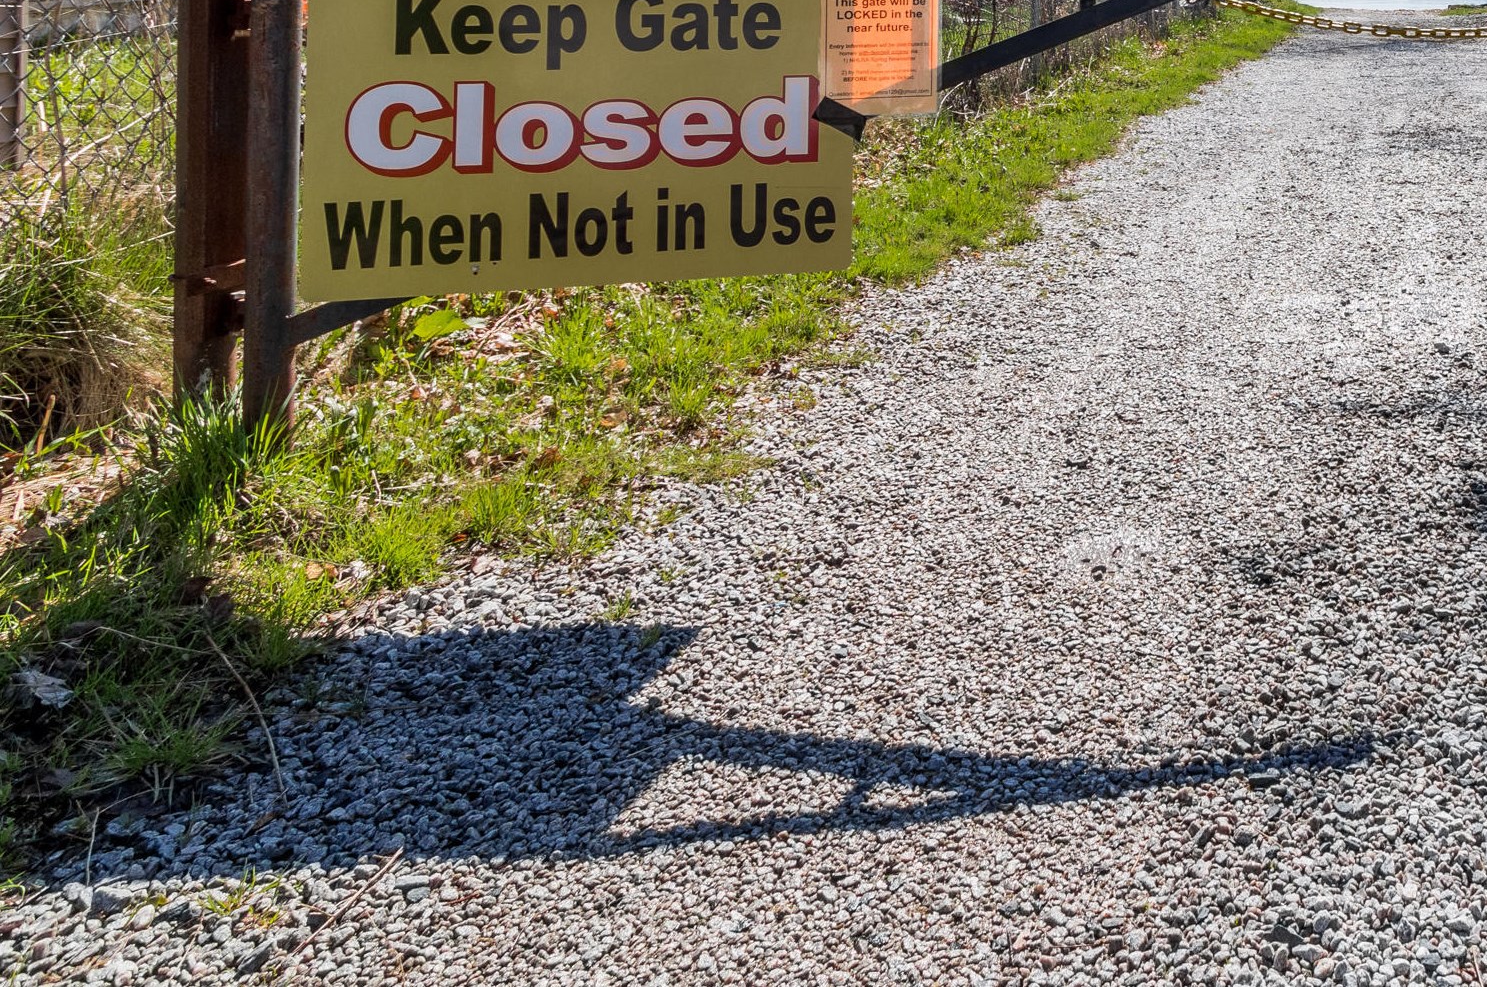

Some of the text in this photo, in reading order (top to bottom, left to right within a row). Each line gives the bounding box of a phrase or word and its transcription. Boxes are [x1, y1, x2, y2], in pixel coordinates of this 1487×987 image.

[837, 9, 923, 20] LOCKED in the
[847, 23, 913, 33] near future.
[345, 73, 821, 178] Closed
[323, 182, 837, 271] When Not in Use
